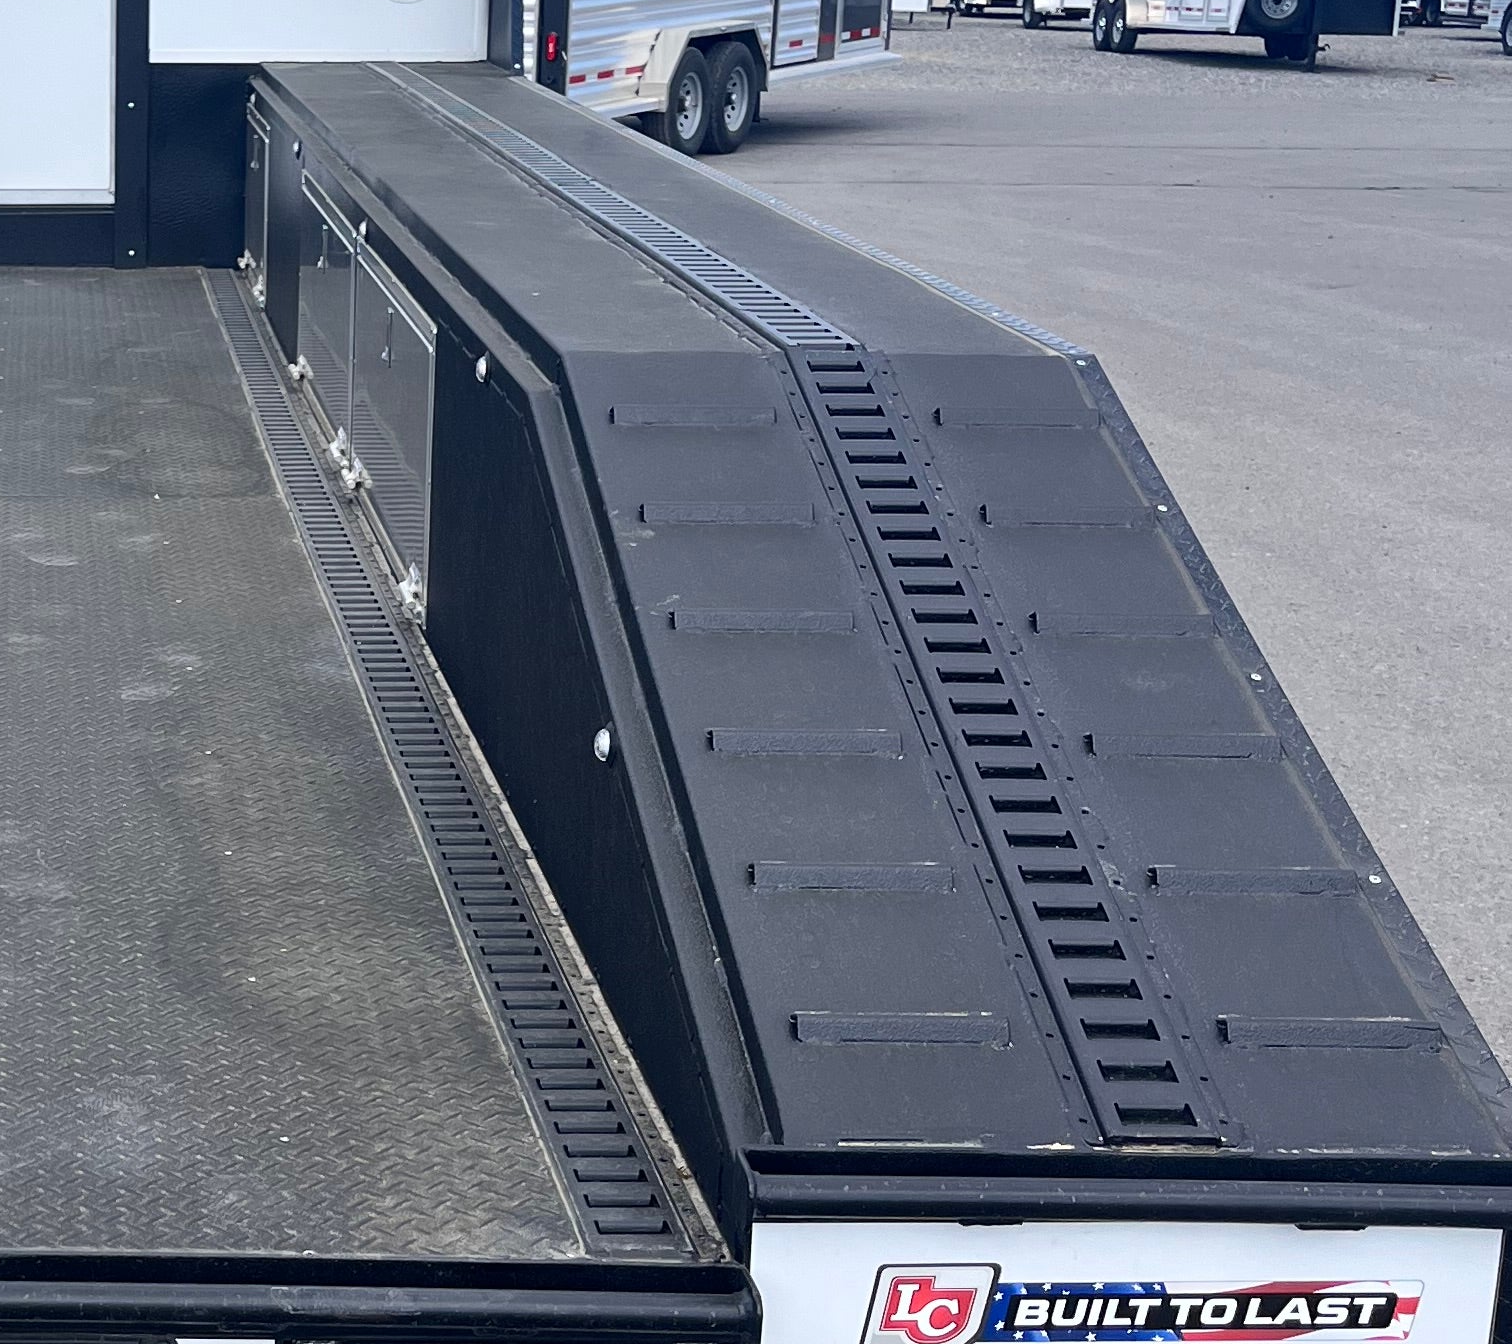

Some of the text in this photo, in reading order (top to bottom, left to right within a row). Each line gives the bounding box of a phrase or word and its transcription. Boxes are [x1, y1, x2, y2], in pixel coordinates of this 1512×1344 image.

[889, 1282, 1388, 1337] LC BUILT TO LAST
